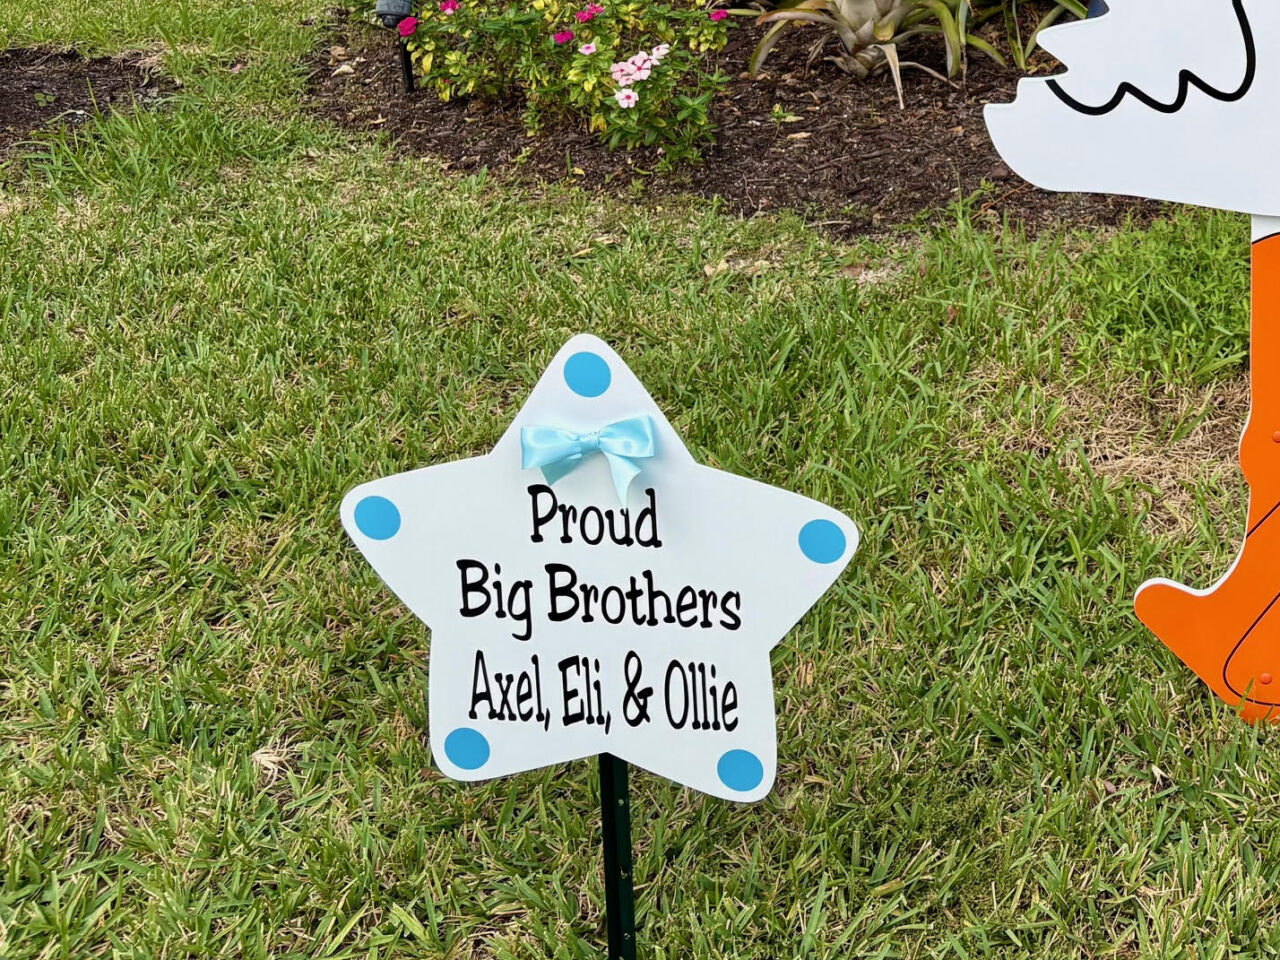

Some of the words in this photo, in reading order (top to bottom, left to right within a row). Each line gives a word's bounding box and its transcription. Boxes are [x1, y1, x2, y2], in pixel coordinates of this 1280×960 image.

[527, 484, 662, 548] Proud
[456, 559, 533, 641] Big
[545, 563, 741, 630] Brothers
[468, 650, 550, 732] Axel,
[558, 655, 611, 734] Eli,
[623, 650, 653, 727] &
[665, 660, 738, 732] Ollie
